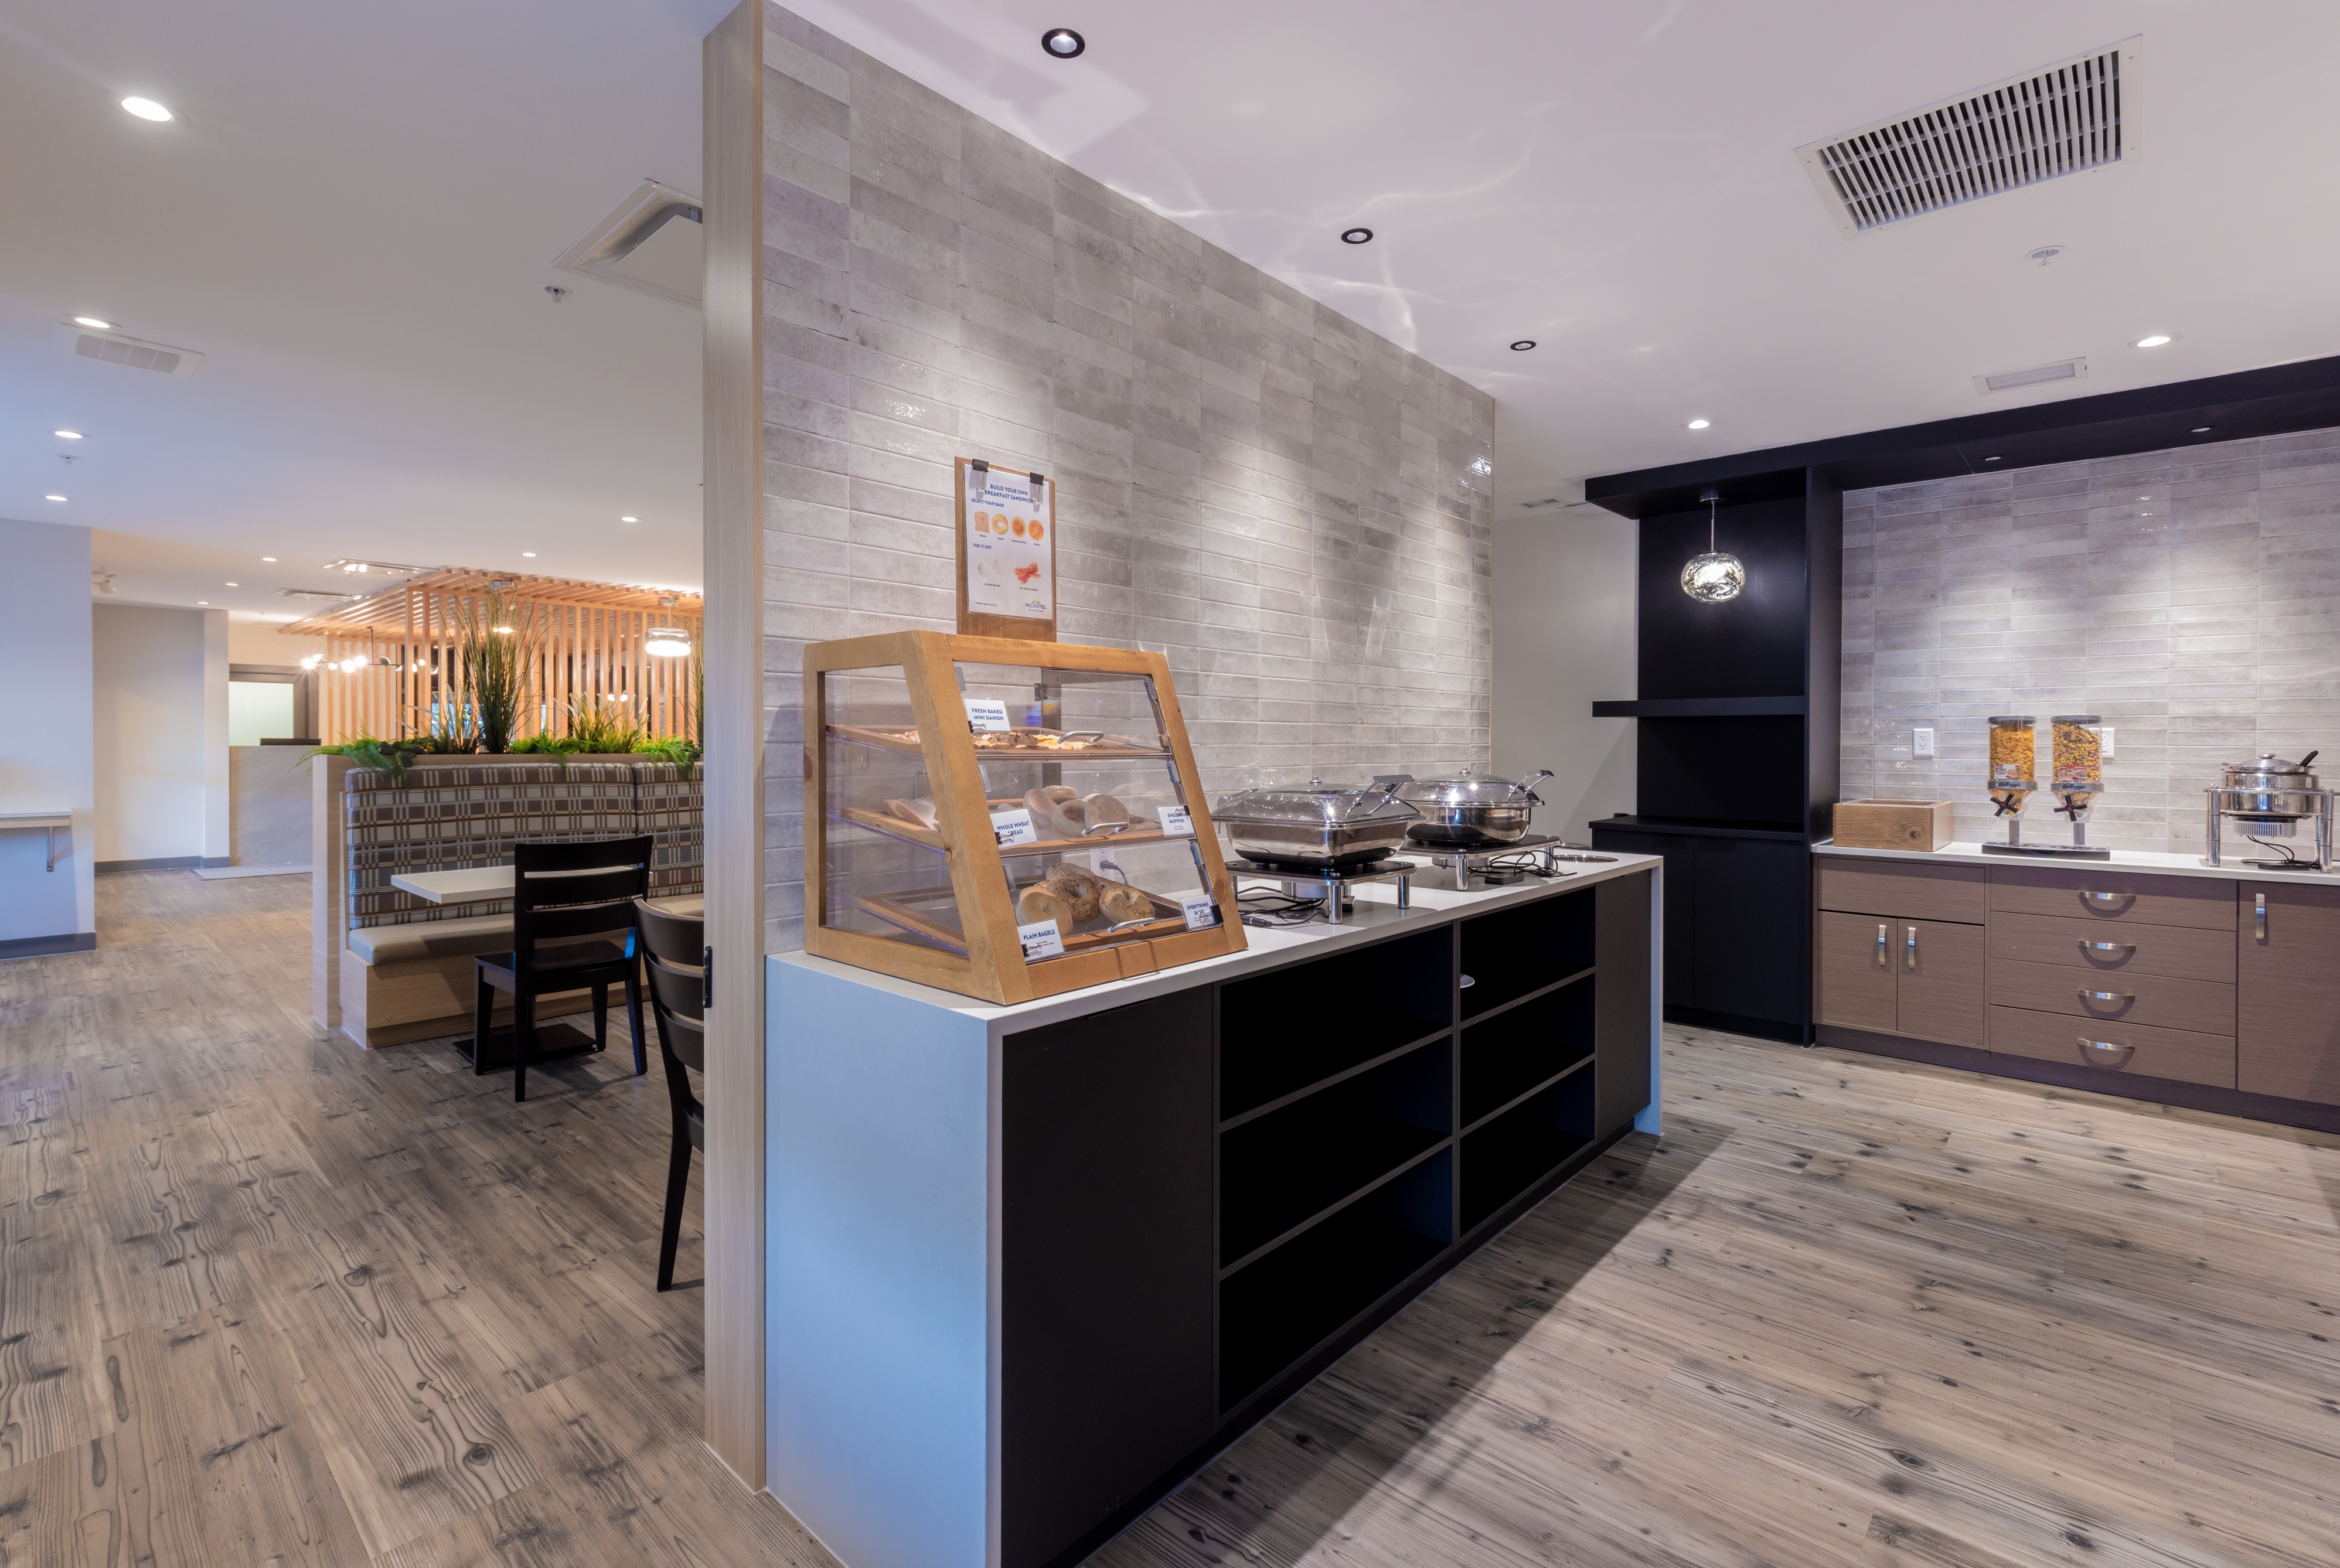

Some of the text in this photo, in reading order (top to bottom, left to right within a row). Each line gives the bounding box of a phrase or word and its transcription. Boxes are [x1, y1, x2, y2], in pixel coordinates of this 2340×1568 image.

[985, 490, 1034, 504] BREAKFAST SANDWICH
[1023, 929, 1055, 940] PLAIN BAGELS
